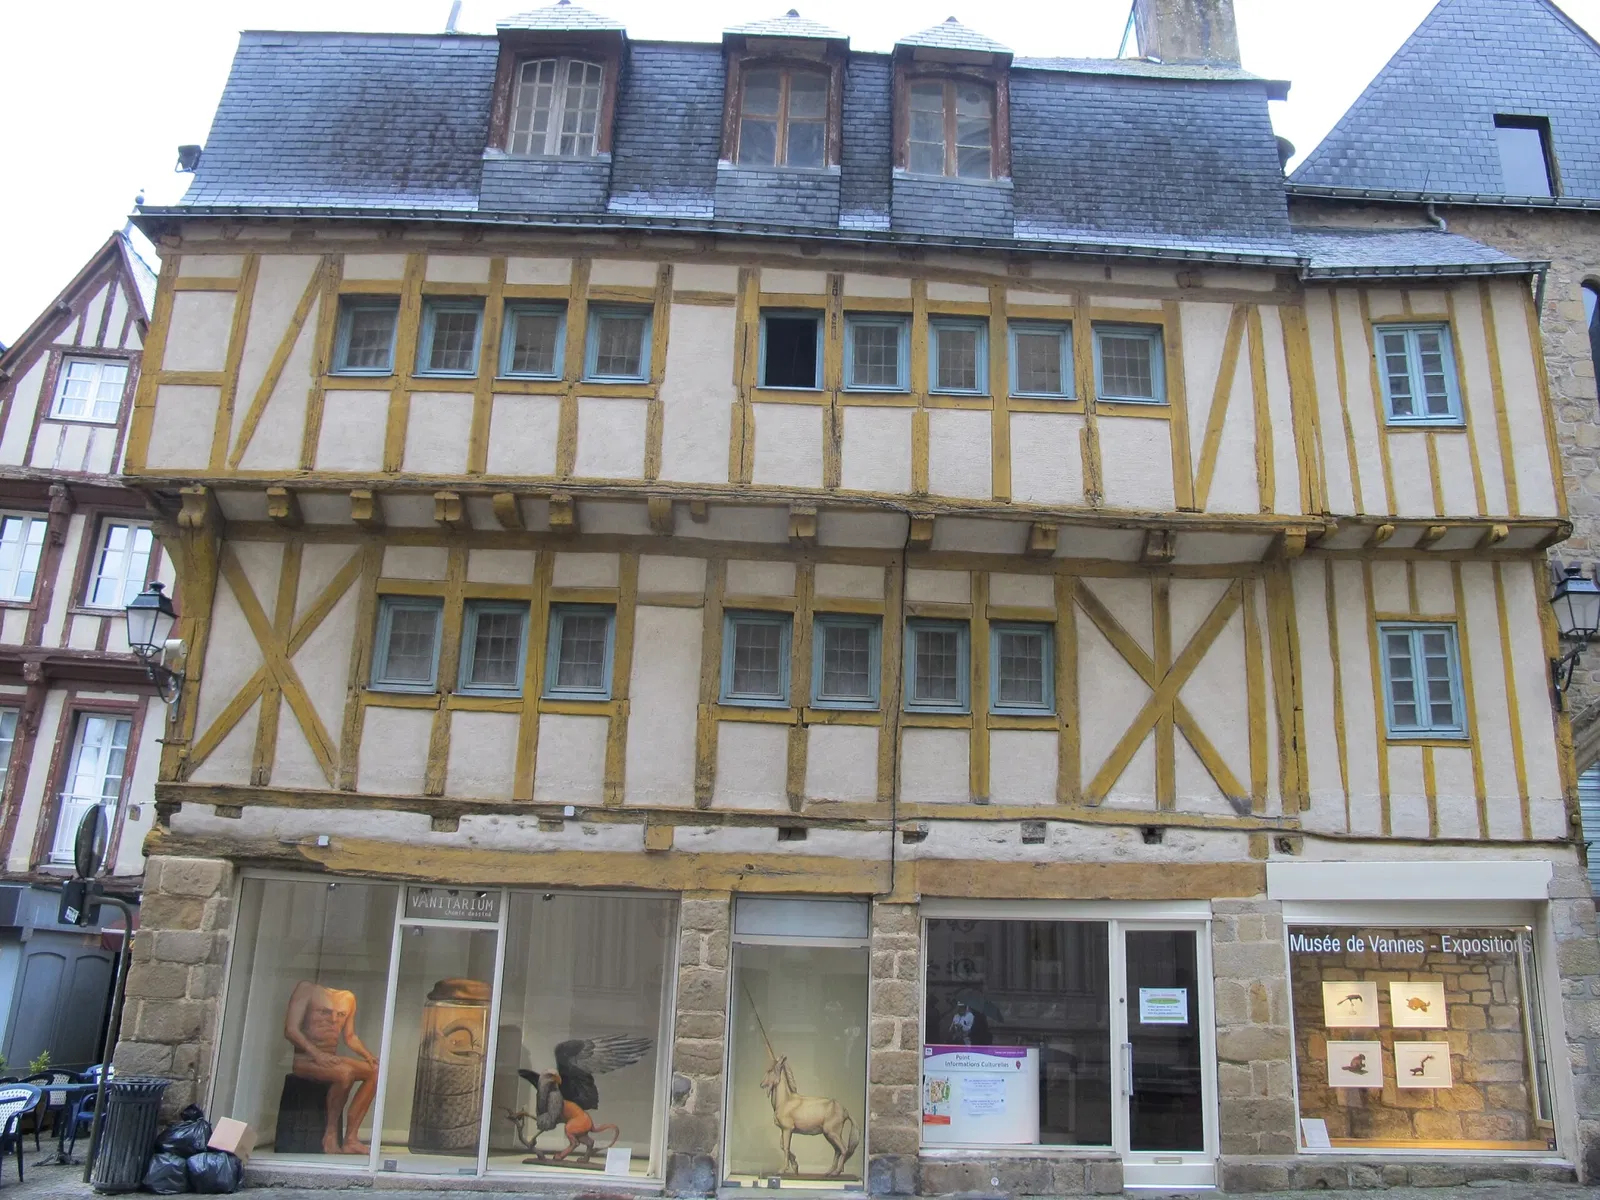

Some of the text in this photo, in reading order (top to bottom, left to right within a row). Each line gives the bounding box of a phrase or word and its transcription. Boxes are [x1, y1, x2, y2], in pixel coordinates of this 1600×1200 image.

[412, 893, 494, 911] VANITARIUM
[1289, 934, 1341, 952] Musée
[1346, 935, 1365, 953] de
[1368, 935, 1425, 953] Vannes
[1441, 935, 1532, 956] Expositions
